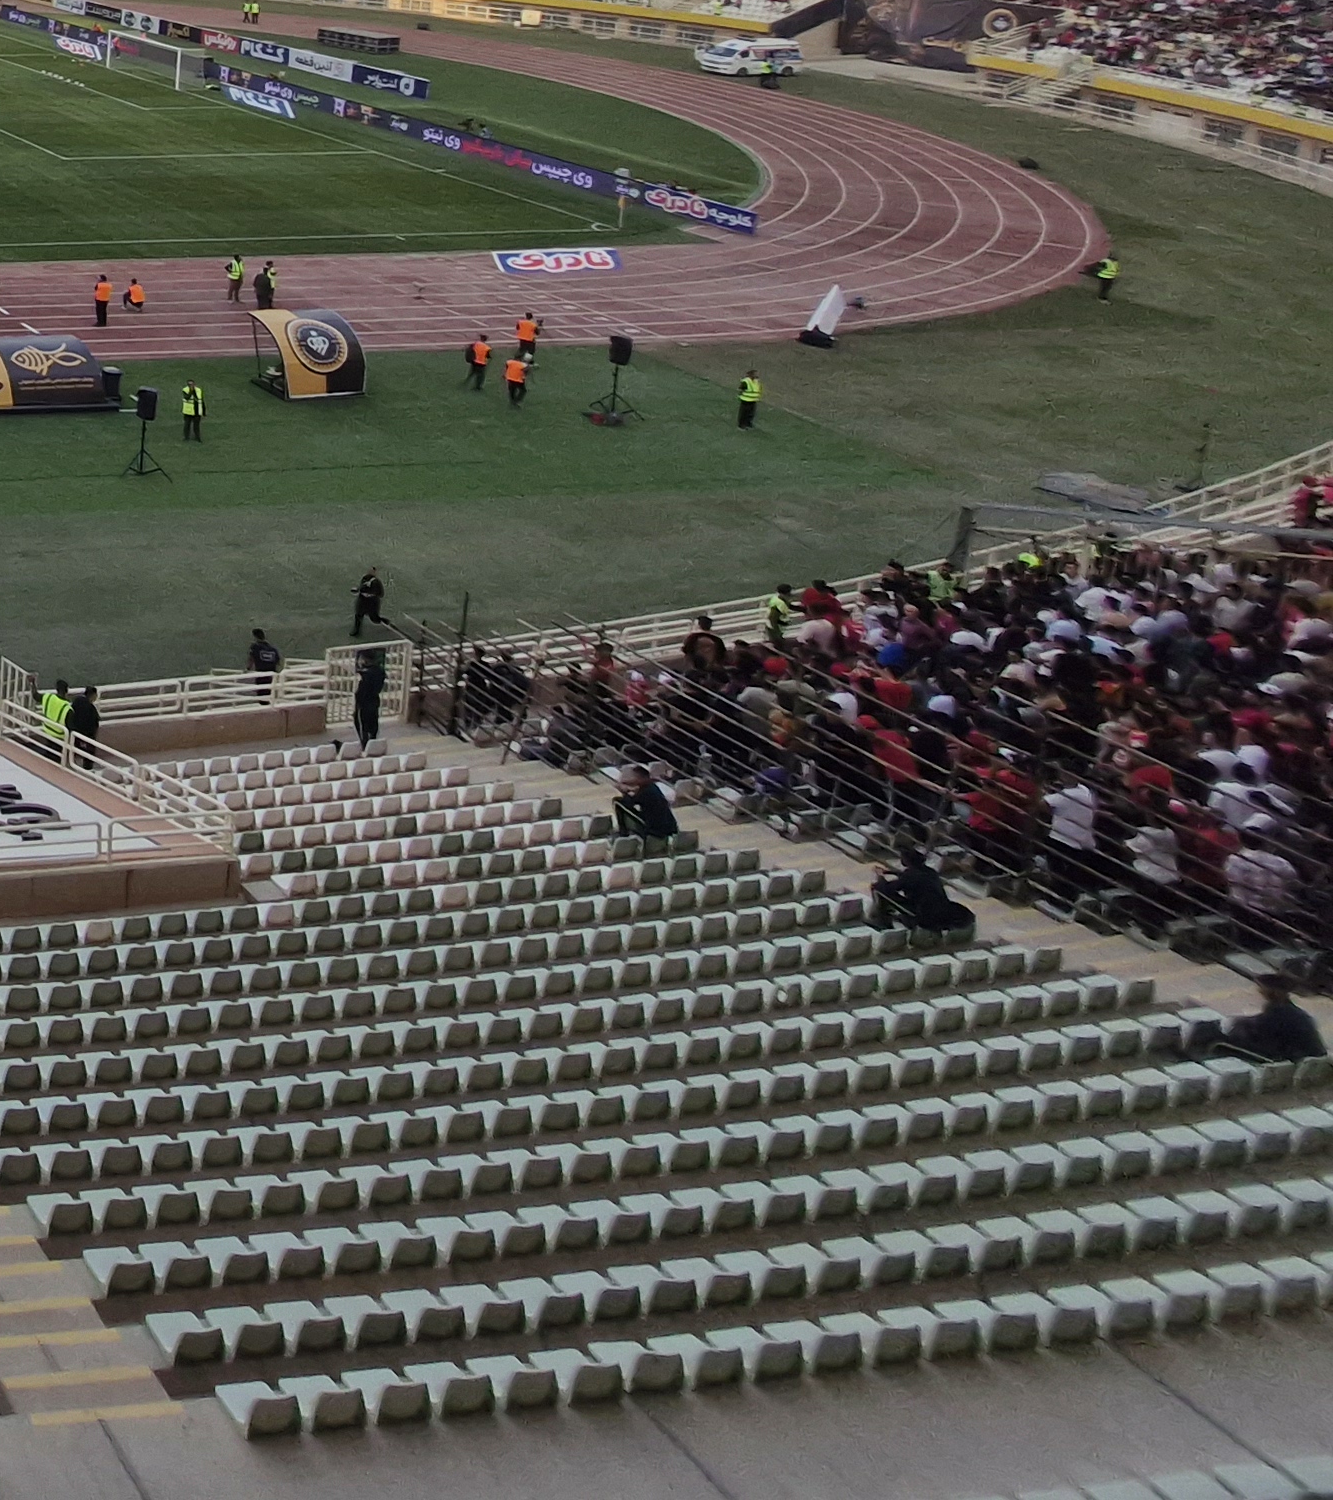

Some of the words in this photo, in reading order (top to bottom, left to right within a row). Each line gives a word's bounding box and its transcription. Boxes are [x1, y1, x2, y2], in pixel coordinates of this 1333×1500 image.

[57, 36, 96, 59] نادری
[646, 189, 708, 219] نادری
[708, 207, 753, 228] کلوچه
[508, 250, 613, 271] نادری
